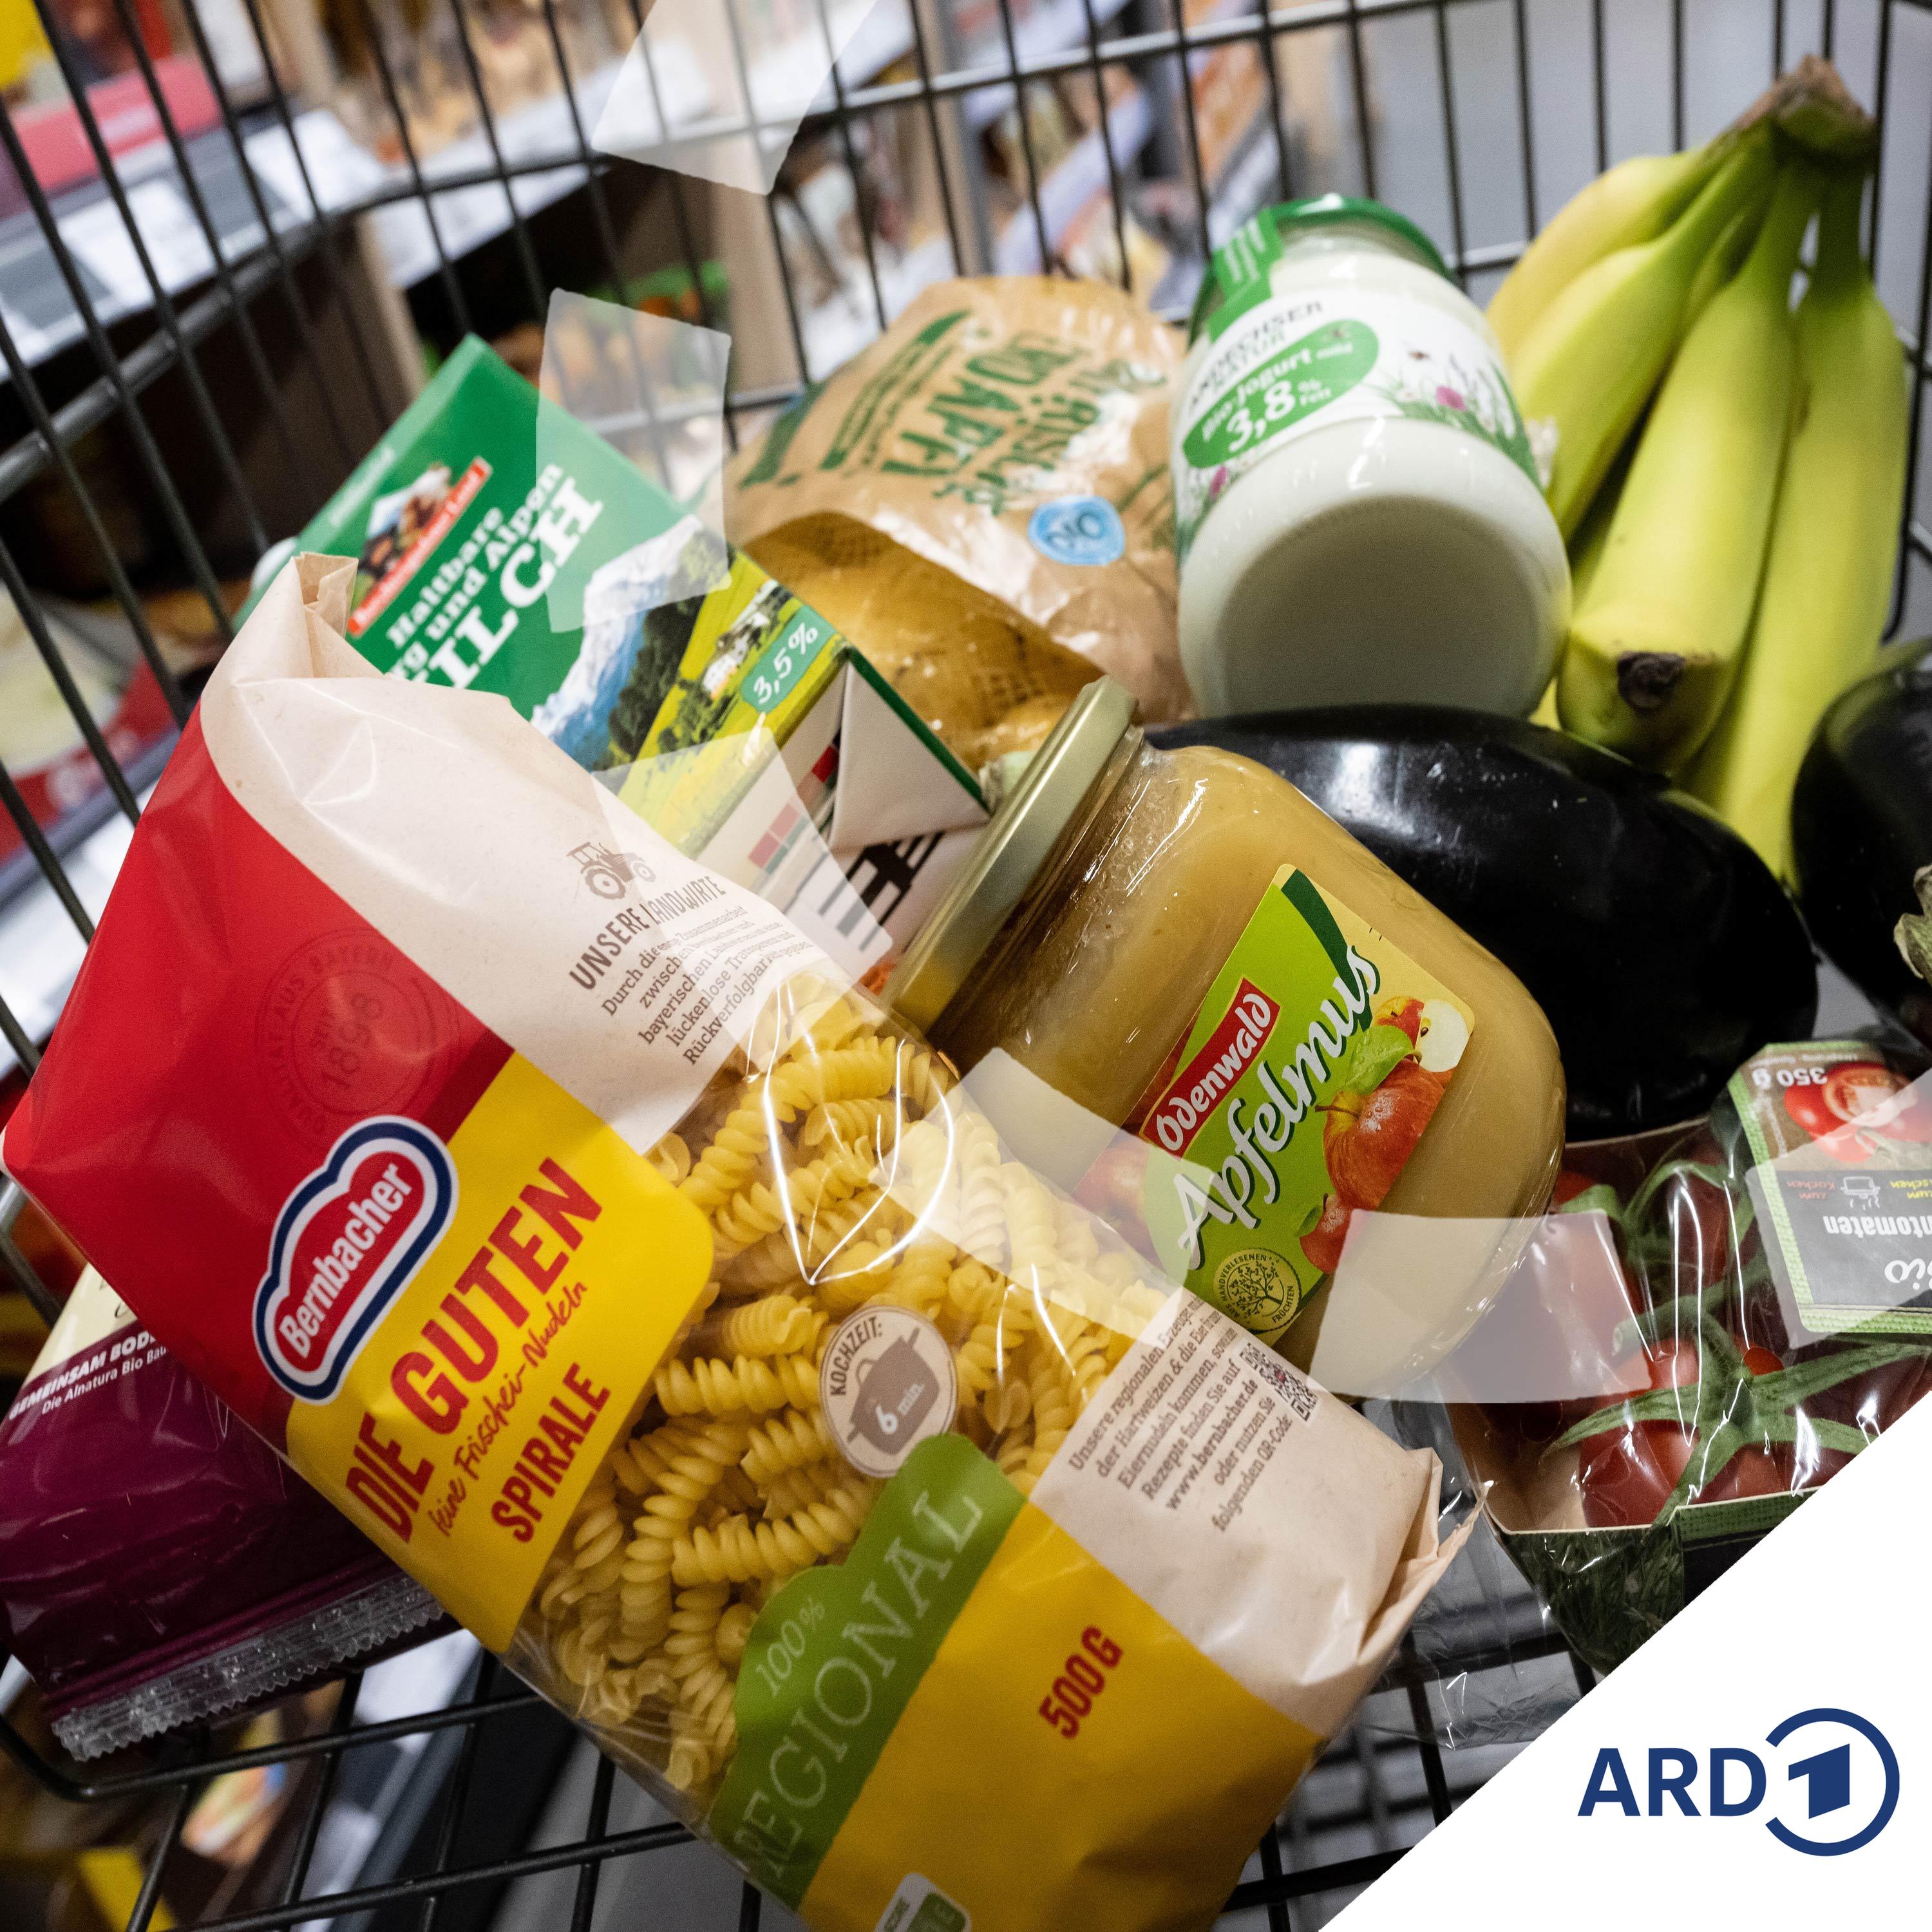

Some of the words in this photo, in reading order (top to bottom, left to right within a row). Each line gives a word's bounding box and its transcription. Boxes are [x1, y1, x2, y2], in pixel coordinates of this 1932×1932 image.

[1227, 381, 1296, 452] 3,8
[387, 507, 502, 649] Haltbare
[412, 476, 604, 690] ILCH
[424, 565, 488, 640] und
[484, 463, 563, 572] Alpen
[569, 907, 650, 990] UNSERE
[640, 875, 726, 925] LANDWIRTE
[601, 968, 643, 1017] Durch
[638, 947, 660, 970] die
[639, 946, 694, 1010] zwischen
[320, 992, 384, 1090] 1898
[637, 956, 712, 1045] bayerischen
[666, 969, 731, 1048] lückenlose
[1156, 992, 1272, 1153] Odenwald
[1173, 944, 1381, 1271] Apfelmus
[1776, 1067, 1828, 1087] 350
[279, 1162, 414, 1359] Bernbacher
[389, 1156, 603, 1436] GUTEN
[1218, 1253, 1267, 1302] HANDVERLESENEN
[1884, 1258, 1932, 1291] io
[42, 1396, 62, 1416] Die
[64, 1367, 118, 1403] Alnatura
[122, 1356, 144, 1376] Bio
[110, 1330, 156, 1362] BOD
[830, 1316, 882, 1396] KOCHZEIT:
[490, 1362, 611, 1544] SPIRALE
[875, 1403, 898, 1435] 6
[1068, 1413, 1115, 1471] Unsere
[1113, 1347, 1165, 1416] regionalen
[1096, 1446, 1121, 1479] der
[1119, 1376, 1173, 1450] Hartweizen
[1170, 1359, 1184, 1375] &
[1178, 1341, 1197, 1363] die
[1117, 1411, 1177, 1491] Eiernudeln
[1171, 1359, 1218, 1412] kommen,
[1141, 1438, 1189, 1501] Rezepte
[1184, 1405, 1213, 1441] finden
[1207, 1381, 1227, 1410] Sie
[1222, 1358, 1242, 1387] auf
[1166, 1378, 1258, 1511] www.bernbacher.de
[1213, 1450, 1238, 1486] oder
[1236, 1416, 1265, 1454] nutzen
[1262, 1396, 1277, 1416] Sie
[345, 1411, 435, 1544] DIE
[1211, 1457, 1265, 1533] folgenden
[734, 1490, 984, 1883] REGIONAL
